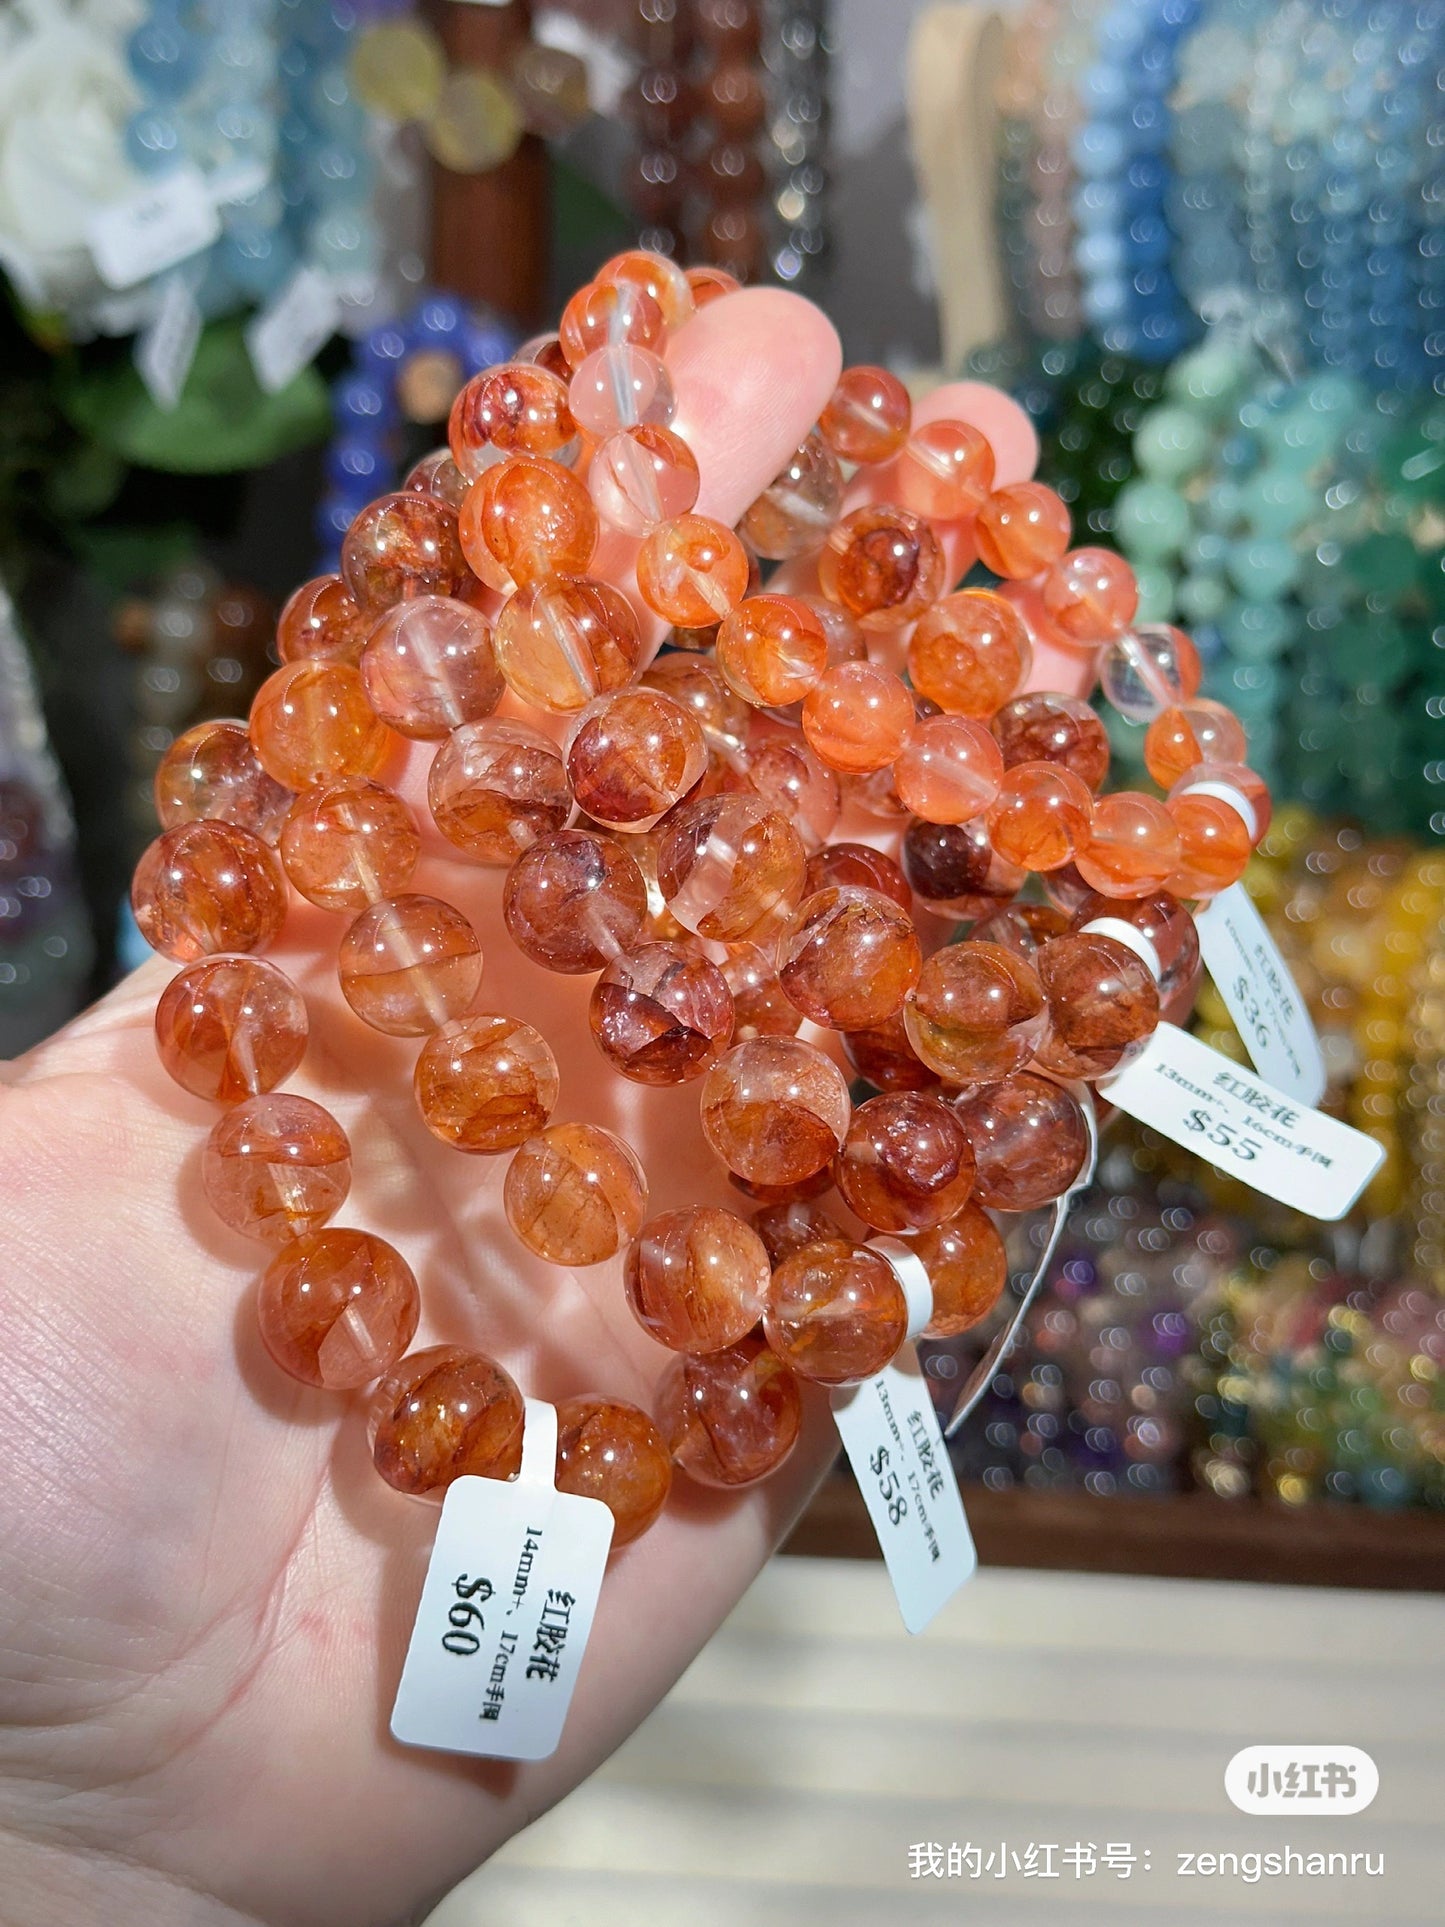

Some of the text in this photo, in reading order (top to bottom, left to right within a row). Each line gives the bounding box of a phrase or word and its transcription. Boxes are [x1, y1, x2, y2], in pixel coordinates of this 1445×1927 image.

[1233, 974, 1271, 1049] $36
[1182, 1108, 1264, 1162] $55
[1212, 1071, 1302, 1130] 红胶花
[868, 1444, 909, 1527] $58
[906, 1409, 946, 1502] 红胶花
[441, 1572, 497, 1656] $60
[525, 1588, 577, 1683] 红胶花
